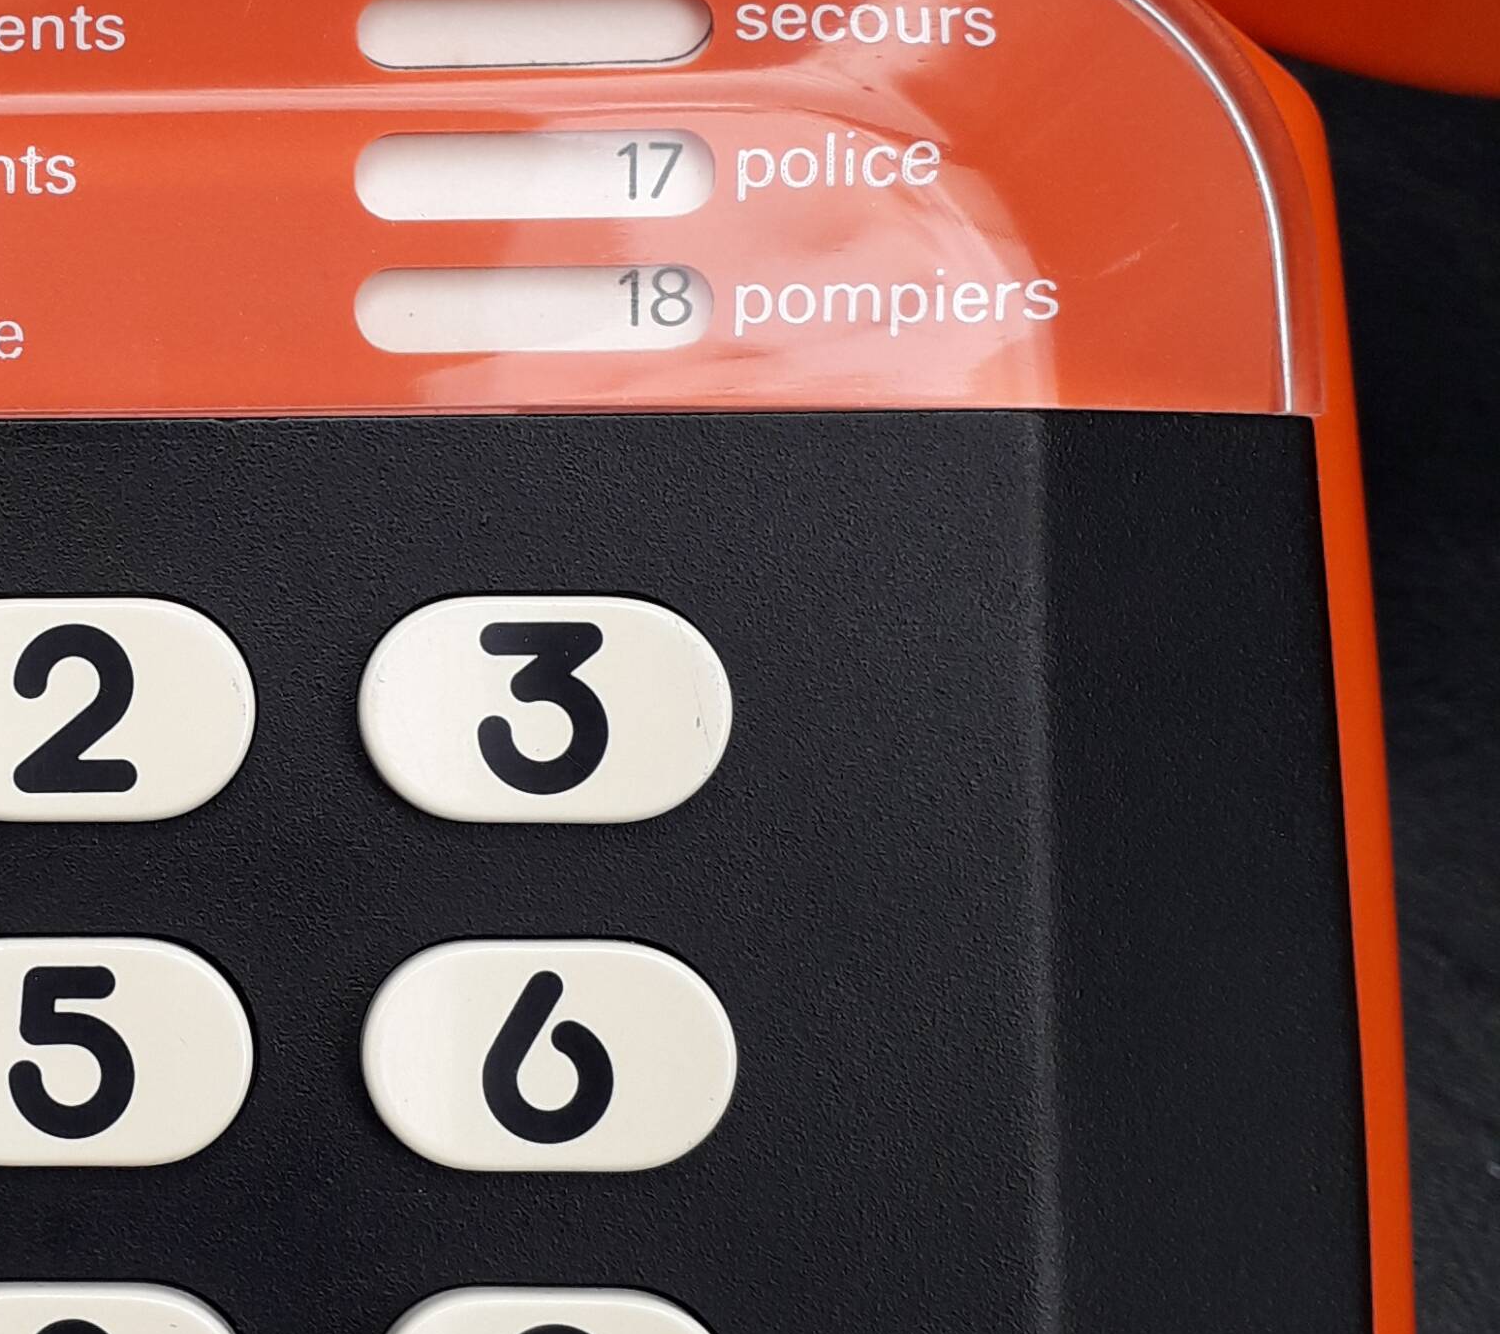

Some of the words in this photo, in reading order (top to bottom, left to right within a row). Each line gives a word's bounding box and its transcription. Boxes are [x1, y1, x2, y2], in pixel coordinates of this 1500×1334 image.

[735, 0, 997, 47] secours
[616, 141, 684, 201] 17
[736, 131, 941, 203] police
[619, 269, 693, 327] 18
[734, 268, 1059, 341] pompiers
[14, 624, 137, 793] 2
[478, 622, 608, 795] 3
[9, 966, 134, 1139] 5
[483, 971, 613, 1144] 6
